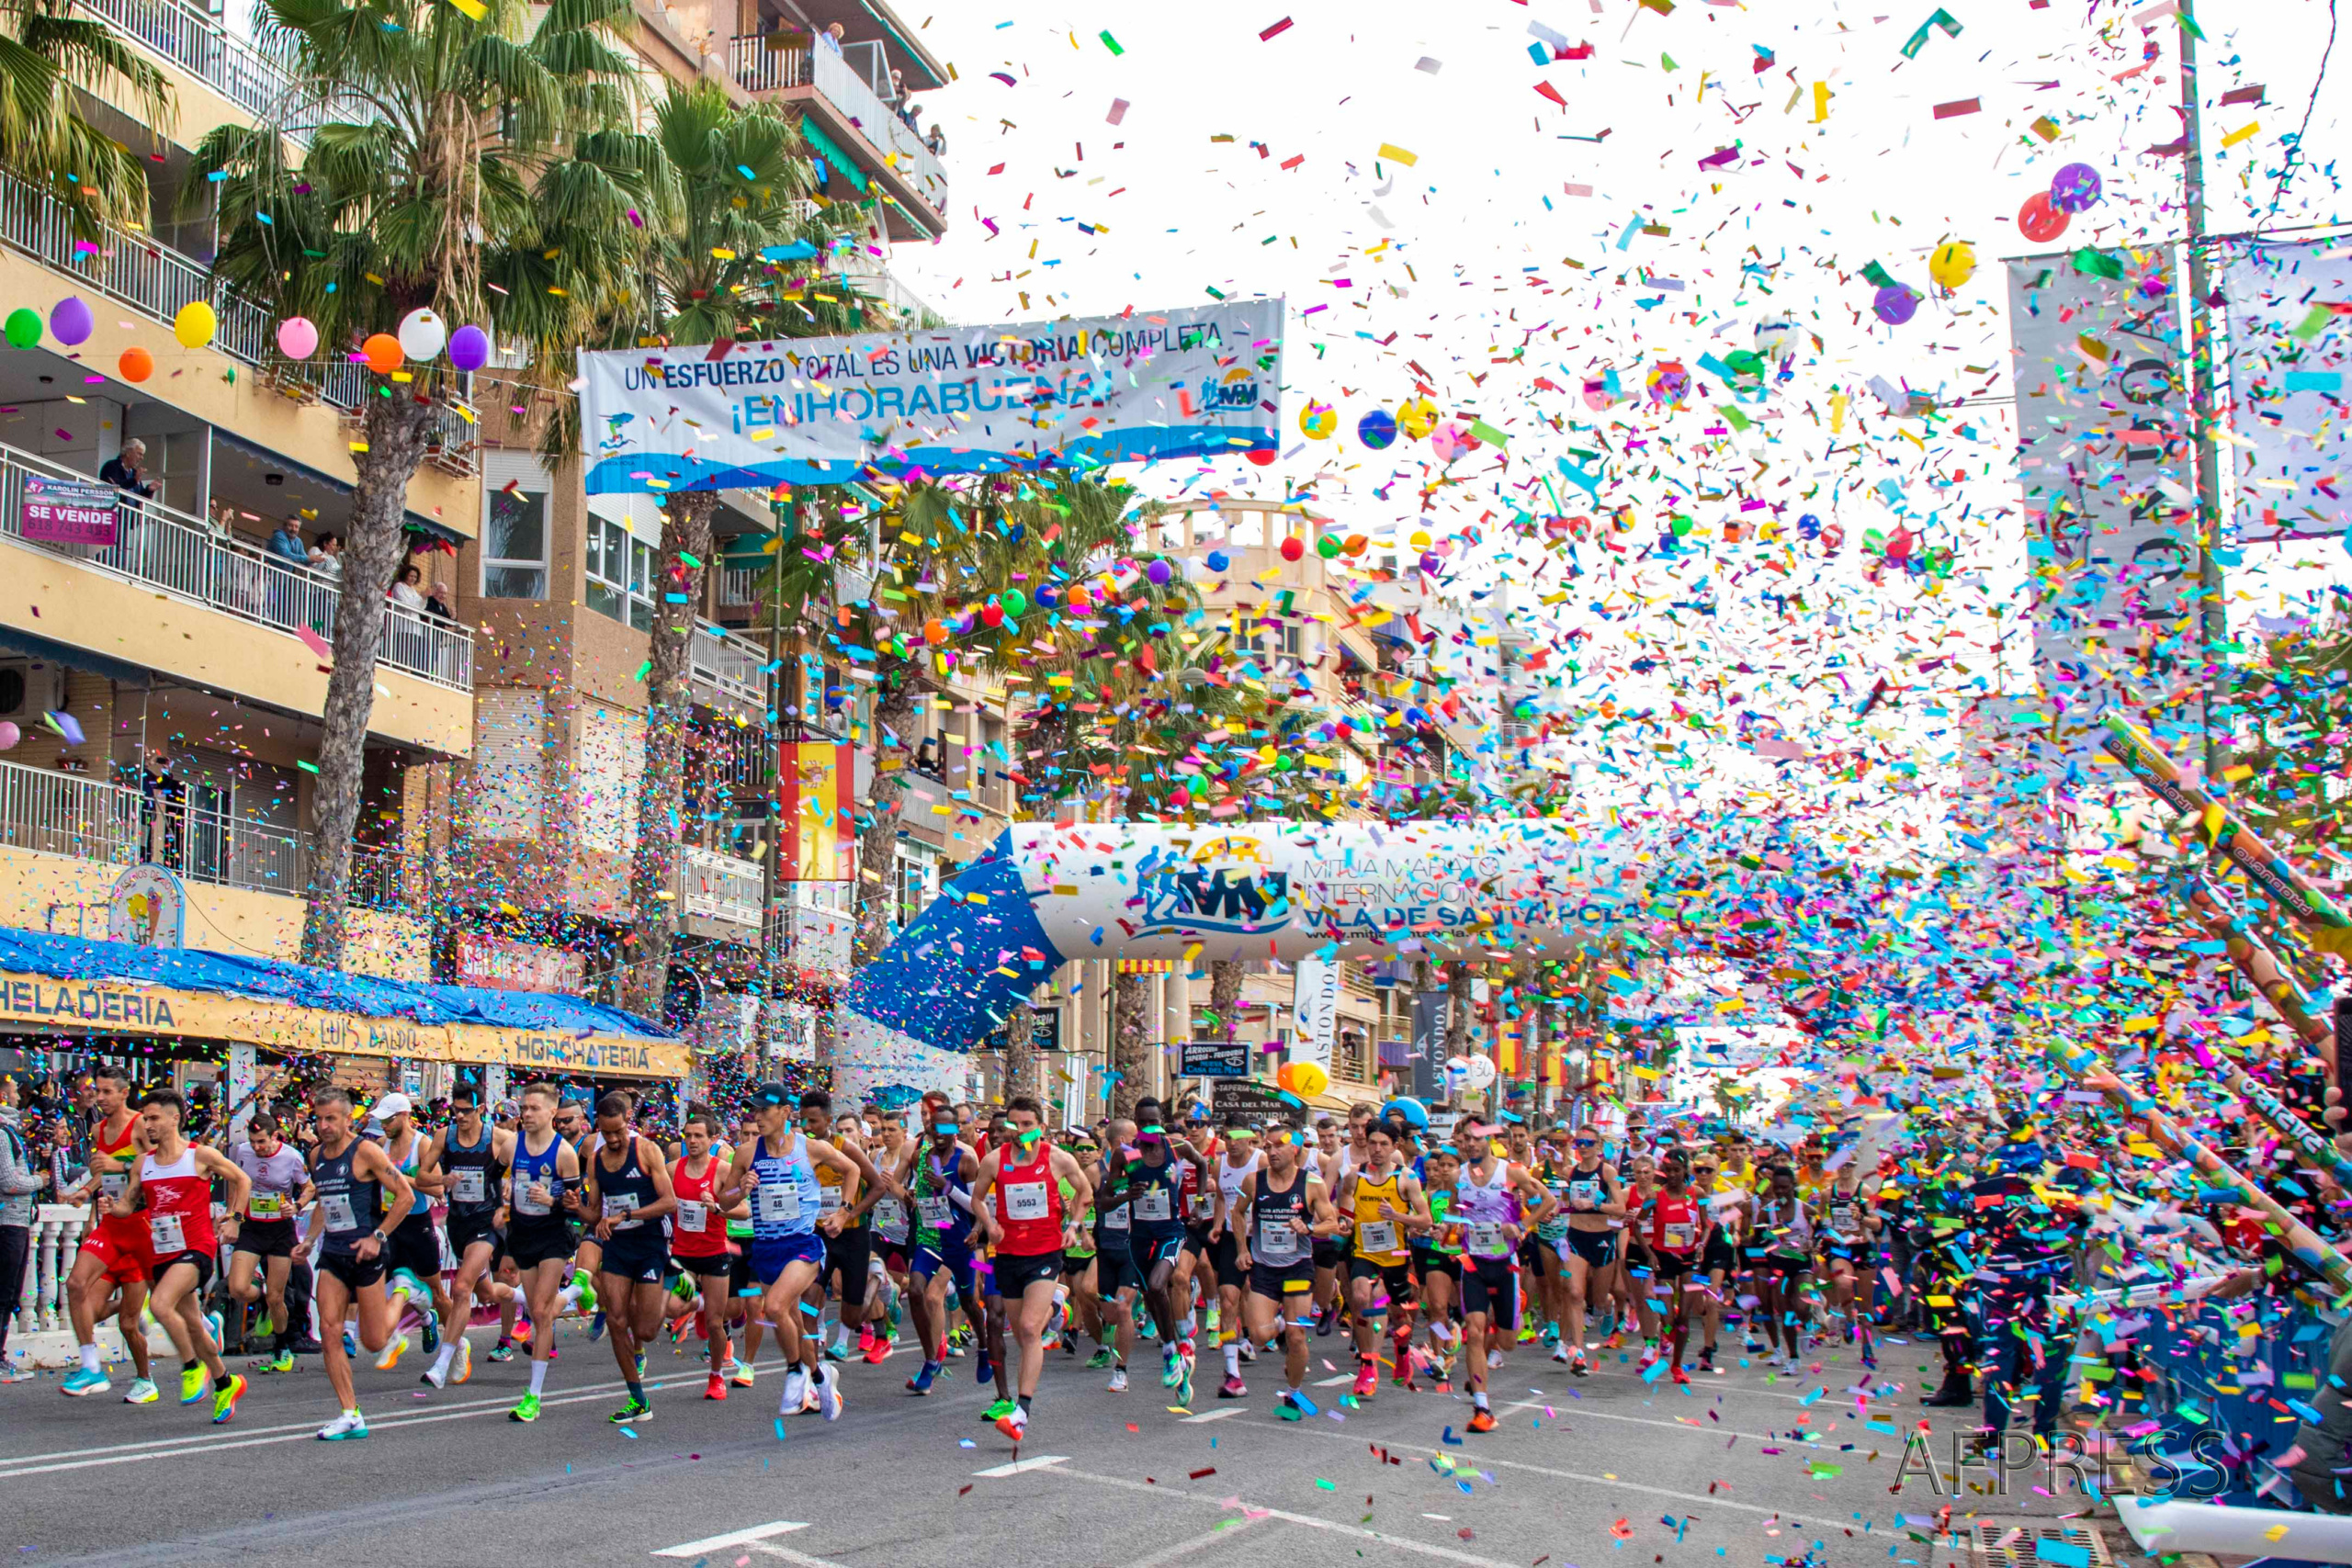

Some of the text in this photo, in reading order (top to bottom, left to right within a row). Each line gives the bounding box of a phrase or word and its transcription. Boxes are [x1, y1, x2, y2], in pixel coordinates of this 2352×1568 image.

[626, 366, 656, 390] UN
[665, 358, 785, 388] ESFUERZO
[872, 349, 899, 376] ES
[908, 344, 957, 373] UNA
[1092, 322, 1223, 357] COMPLETA
[47, 484, 114, 496] KAROLIN PERSSON
[28, 505, 112, 525] SE VENDE
[2234, 847, 2313, 916] PRODUCTO
[1384, 907, 1426, 926] DE
[0, 982, 175, 1028] HELADERIA
[321, 1018, 359, 1051] LUIS
[1432, 1003, 1446, 1092] ASTONDOA
[516, 1035, 650, 1070] HORCHATERIA
[773, 1200, 783, 1208] 48
[1017, 1198, 1036, 1208] 5553
[683, 1213, 695, 1222] 799
